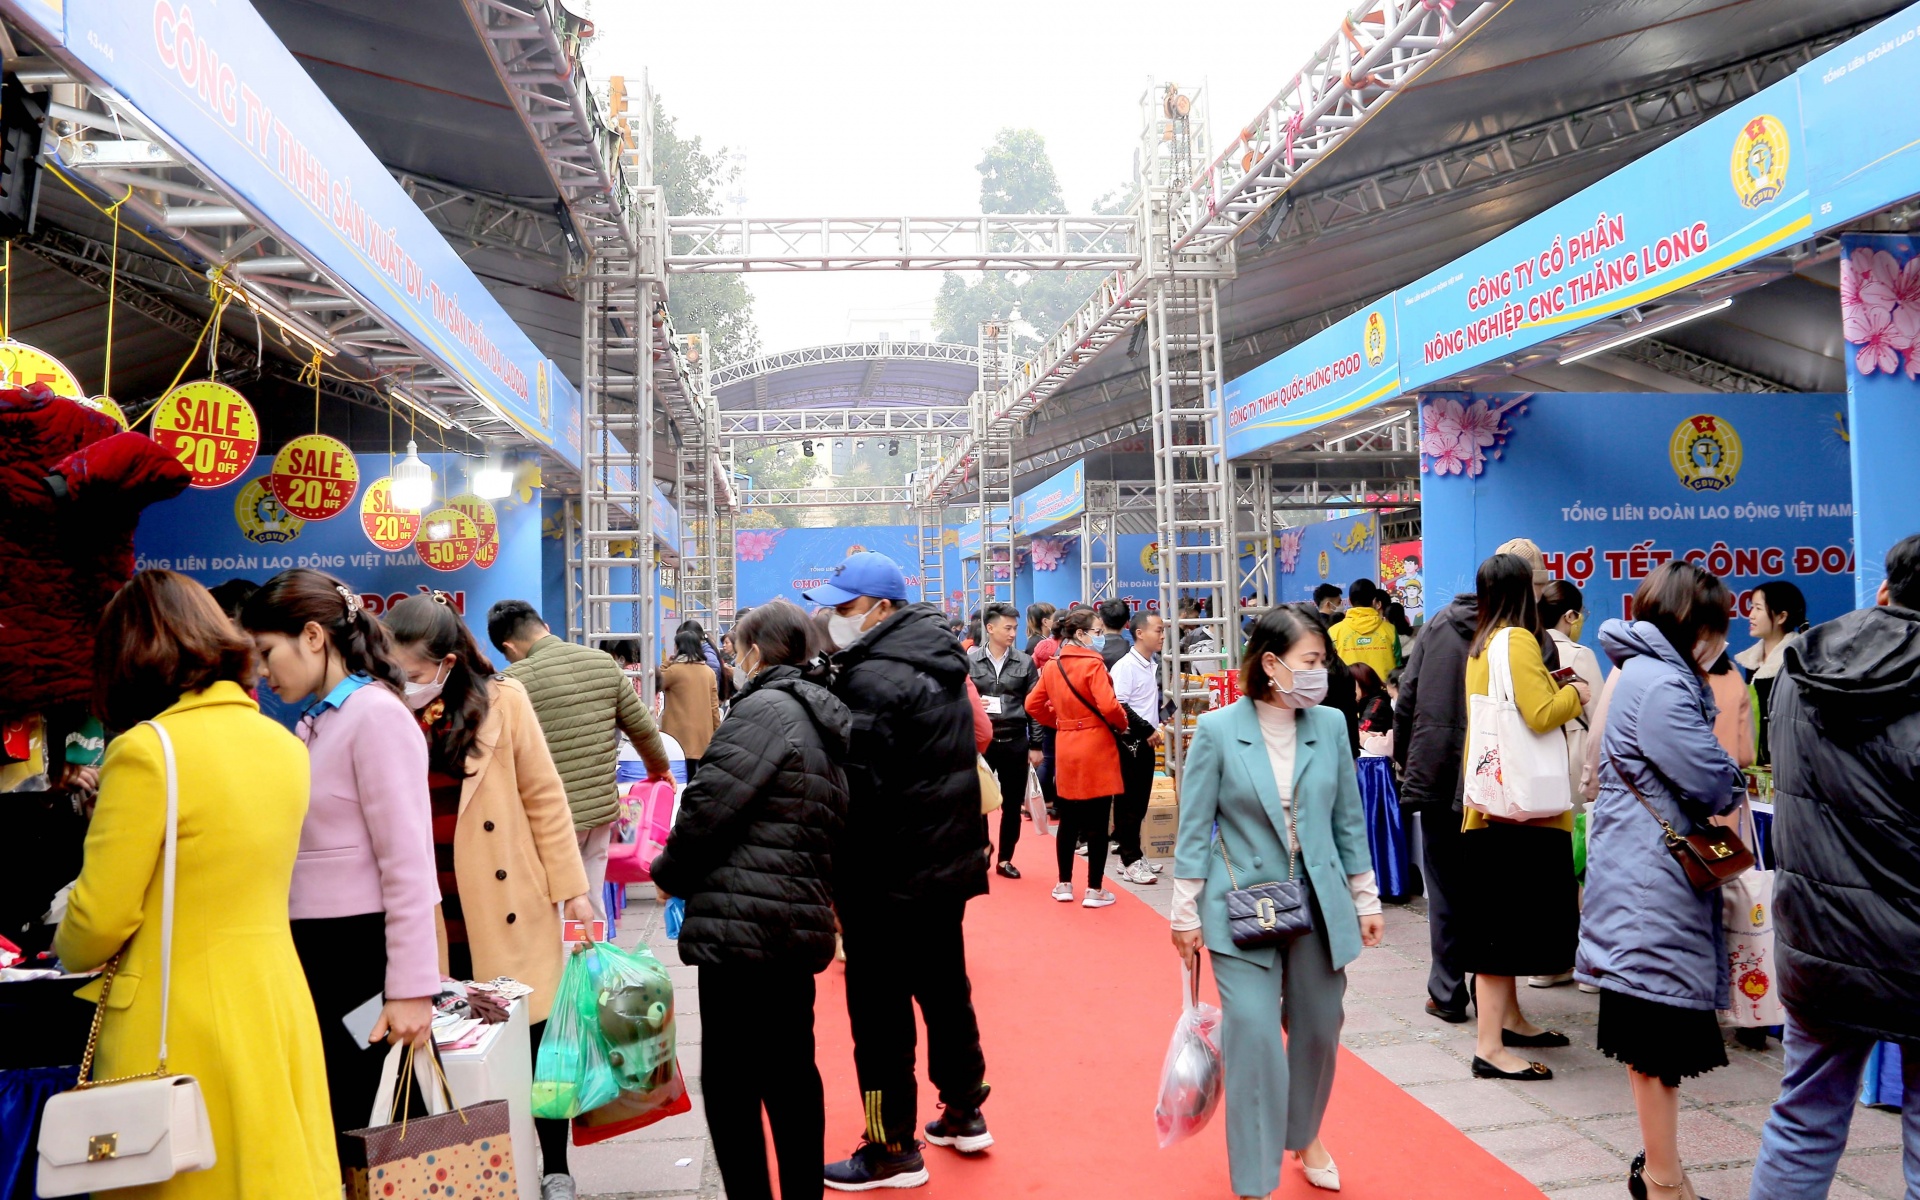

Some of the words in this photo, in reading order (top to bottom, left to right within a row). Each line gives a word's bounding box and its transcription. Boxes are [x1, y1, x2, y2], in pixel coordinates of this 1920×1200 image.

[1896, 30, 1914, 48] LAO
[154, 0, 237, 127] CÔNG
[241, 81, 272, 159] TY
[275, 117, 330, 218] TNHH
[332, 176, 366, 251] SẢN
[368, 216, 404, 287] XUẤT
[405, 254, 423, 304] DV
[430, 279, 447, 328] TM
[447, 292, 467, 347] SẢN
[1820, 201, 1833, 215] 55
[1467, 275, 1512, 312] CÔNG
[1513, 258, 1535, 287] TY
[1538, 235, 1565, 278] CỔ
[1568, 211, 1625, 267] PHẦN
[1424, 327, 1465, 366] NÔNG
[1465, 301, 1525, 343] NGHIỆP
[1527, 286, 1565, 324] CNC
[1567, 254, 1638, 306] THĂNG
[1642, 220, 1709, 275] LONG
[1229, 404, 1248, 429] CÔNG
[1248, 402, 1257, 419] TY
[1258, 387, 1279, 416] TNHH
[1280, 374, 1304, 409] QUỐC
[1305, 366, 1331, 396] HƯNG
[1333, 352, 1361, 384] FOOD
[174, 396, 242, 437] SALE
[217, 461, 238, 475] OFF
[288, 448, 344, 479] SALE
[323, 498, 341, 510] OFF
[1561, 500, 1608, 521] TỔNG
[1612, 502, 1644, 521] LIÊN
[1648, 502, 1695, 521] ĐOÀN
[1699, 505, 1730, 519] LAO
[1734, 502, 1781, 523] ĐỘNG
[1785, 501, 1814, 521] VIỆT
[1818, 503, 1852, 518] NAM
[400, 531, 412, 540] OFF
[135, 552, 171, 571] ỔNG
[175, 554, 207, 571] LIÊN
[212, 553, 257, 570] ĐOÀN
[263, 556, 293, 569] LAO
[297, 552, 346, 571] ĐỘNG
[349, 551, 382, 571] VIỆT
[385, 553, 421, 567] NAM
[456, 553, 469, 561] OFF
[1542, 545, 1596, 589] HỢ
[1684, 540, 1784, 578] CÔNG
